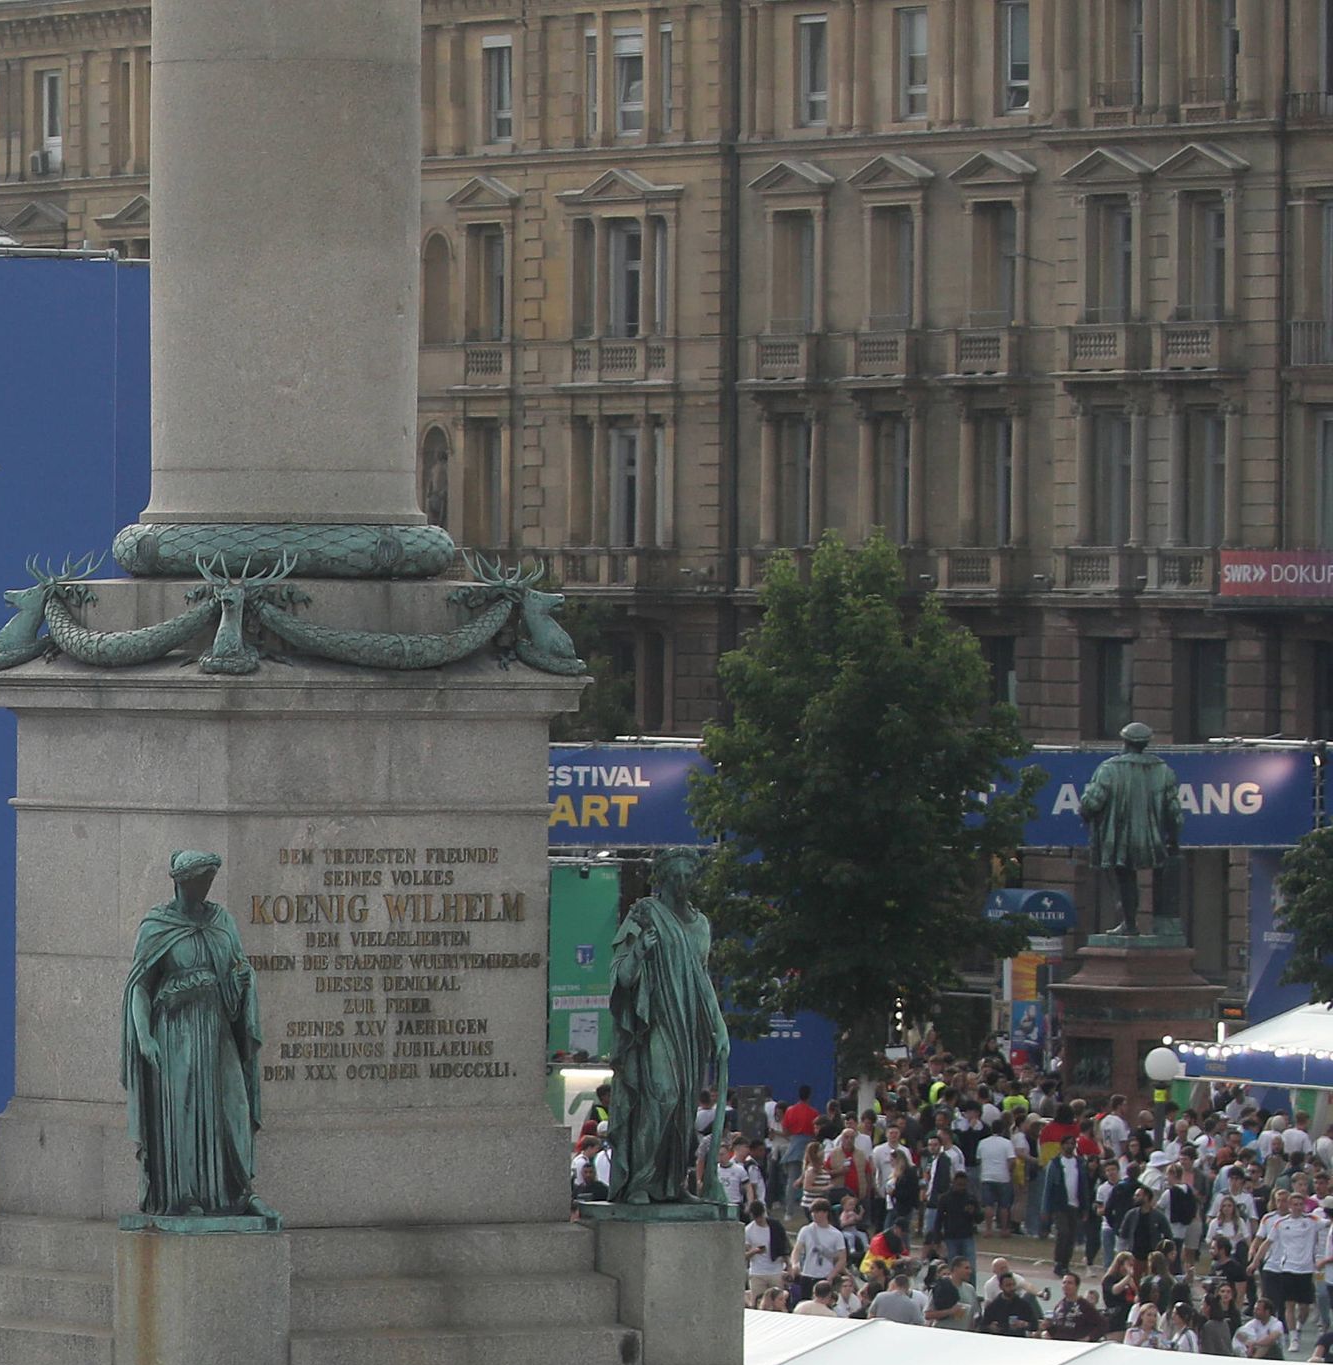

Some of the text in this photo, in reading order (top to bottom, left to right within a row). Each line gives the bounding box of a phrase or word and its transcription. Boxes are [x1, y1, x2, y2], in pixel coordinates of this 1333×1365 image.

[426, 847, 499, 864] FREUNDE
[323, 870, 454, 886] SEINES VOLKES
[250, 893, 526, 925] KOENIG WILHELM
[315, 976, 461, 993] DIESES DENKMAL
[286, 1020, 345, 1037] SEINES
